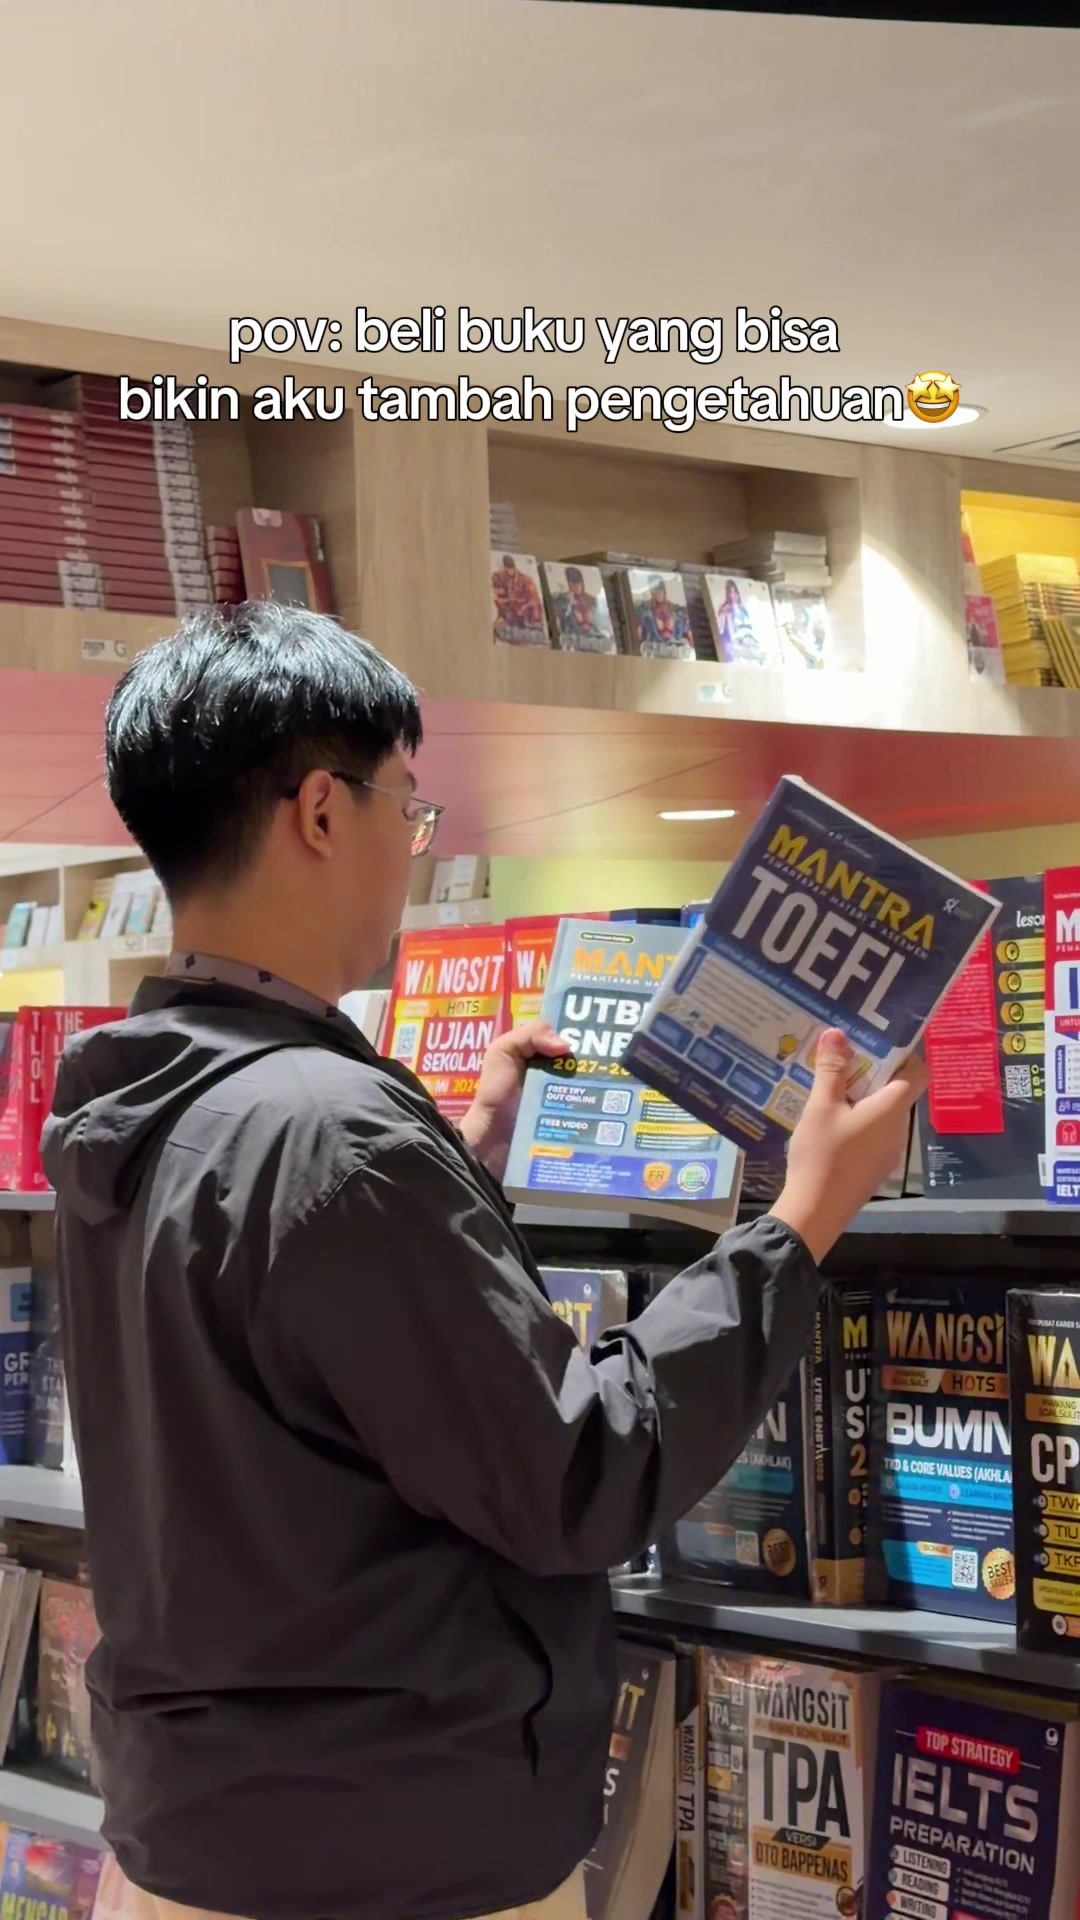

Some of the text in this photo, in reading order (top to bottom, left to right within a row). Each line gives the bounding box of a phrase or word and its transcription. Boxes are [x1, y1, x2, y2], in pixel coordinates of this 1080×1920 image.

[766, 823, 936, 951] MANTRA
[1056, 908, 1080, 943] M
[731, 865, 906, 1032] TOEFL
[405, 955, 505, 996] WANGSIT
[55, 1011, 84, 1032] THE
[447, 1000, 480, 1014] HOTS
[426, 1020, 494, 1051] UJIAN
[422, 1052, 484, 1073] SEKOLAH
[540, 1118, 589, 1129] FREE VIDEO
[1027, 1334, 1080, 1389] WA
[845, 1368, 871, 1402] U
[952, 1373, 996, 1393] HOTS
[846, 1405, 869, 1439] S
[886, 1402, 1012, 1456] BUMN
[901, 1459, 910, 1473] &
[910, 1460, 936, 1476] CORE
[936, 1463, 973, 1480] VALUES
[1030, 1433, 1080, 1486] CP
[1054, 1524, 1079, 1540] TIU
[987, 1560, 1012, 1579] BEST
[753, 1676, 850, 1731] WANGSIT
[925, 1730, 1014, 1769] TOP STRATEGY
[679, 1724, 695, 1832] WANGSIT TPA
[752, 1734, 852, 1839] TPA
[891, 1753, 1039, 1844] IELTS
[785, 1831, 817, 1847] VERSI
[889, 1815, 1036, 1875] PREPARATION
[756, 1842, 848, 1882] OTO BAPPENAS
[903, 1850, 948, 1874] LISTENING
[902, 1872, 939, 1896] READING
[900, 1895, 937, 1918] WRITING
